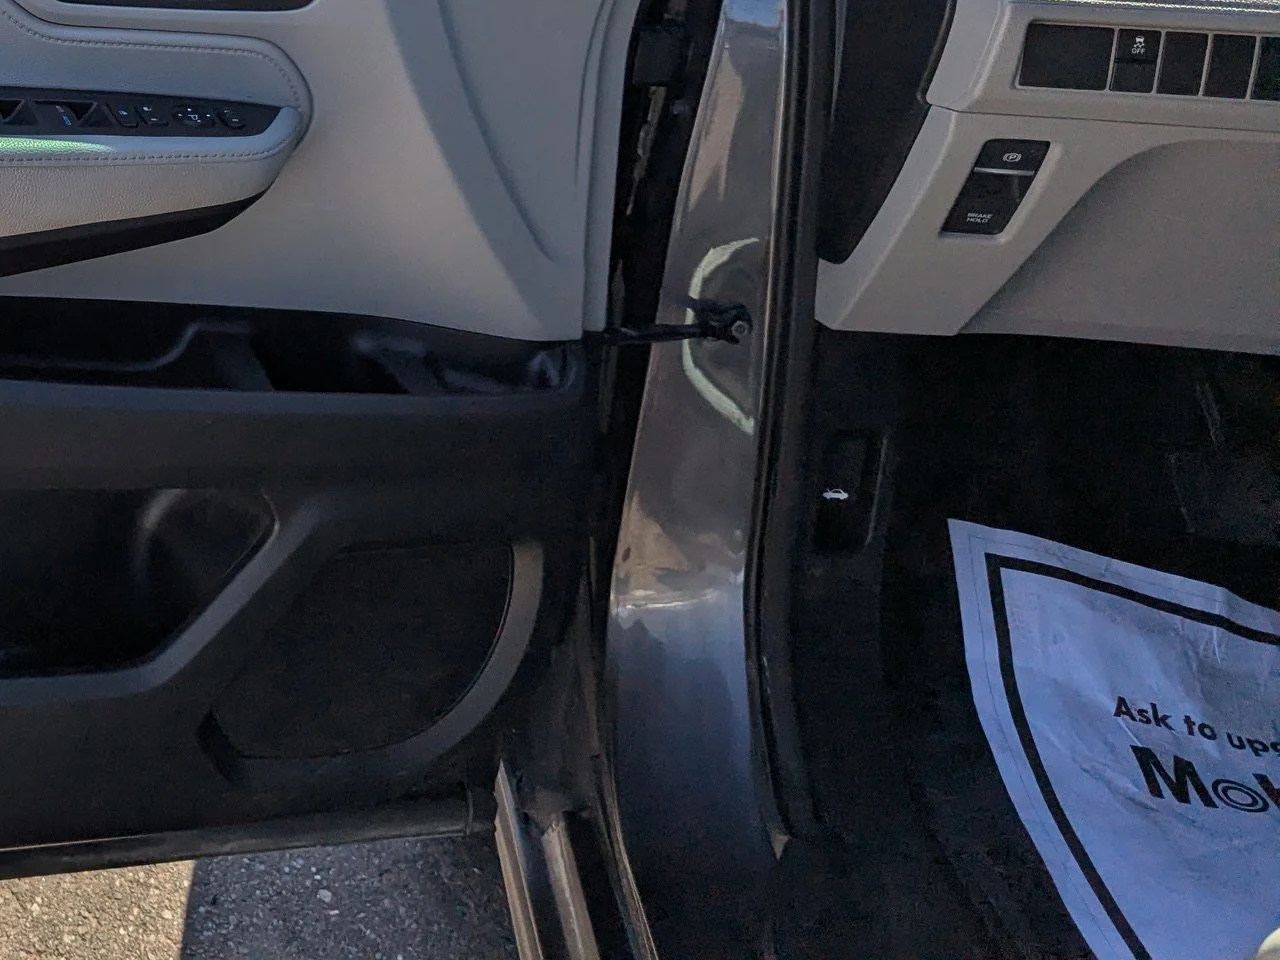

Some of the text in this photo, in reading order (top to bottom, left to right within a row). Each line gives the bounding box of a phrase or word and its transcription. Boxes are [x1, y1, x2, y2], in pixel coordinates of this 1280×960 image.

[1131, 47, 1145, 55] OFF
[1113, 696, 1176, 731] Ask
[1183, 715, 1217, 740] to
